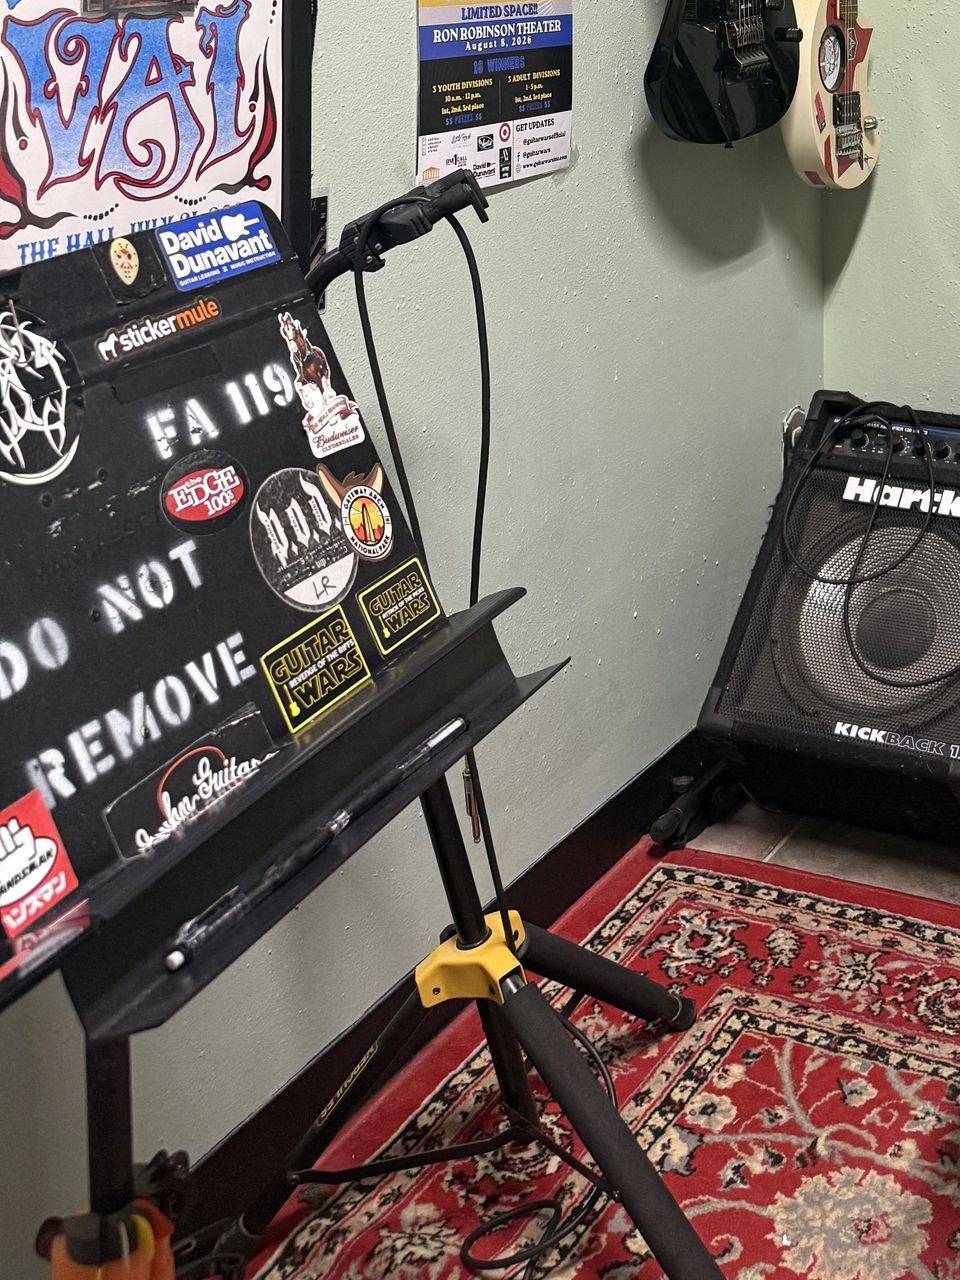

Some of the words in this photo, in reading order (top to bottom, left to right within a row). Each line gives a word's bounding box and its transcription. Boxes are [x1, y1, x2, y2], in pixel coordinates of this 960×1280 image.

[461, 5, 501, 20] LIMITED
[433, 27, 459, 43] RON
[462, 23, 516, 41] ROBINSON
[516, 20, 562, 35] THEATER
[465, 40, 498, 52] August
[511, 35, 532, 46] 2026
[437, 81, 461, 93] YOUTH
[461, 78, 493, 91] DIVISIONS
[532, 68, 561, 80] DIVISIONS
[515, 122, 528, 132] GET
[528, 118, 555, 130] UPDATES
[473, 162, 487, 170] David
[17, 236, 60, 265] THE
[159, 218, 223, 255] David
[168, 228, 273, 279] Dunavant
[118, 298, 220, 353] stickermule
[146, 398, 220, 460] FA
[225, 363, 294, 425] 119
[312, 425, 359, 449] Budweiser
[321, 434, 360, 453] CLYDESDALES
[168, 465, 241, 512] EDGE
[185, 477, 203, 489] the
[343, 487, 368, 510] GATEWAY
[368, 490, 386, 510] ARCH
[349, 535, 379, 555] NATIONAL
[377, 534, 392, 553] PARK
[96, 538, 204, 633] NOT
[312, 574, 337, 601] LR
[368, 571, 422, 617] GUITAR
[382, 605, 399, 619] ATTACK
[398, 600, 405, 608] OF
[404, 595, 414, 605] THE
[413, 586, 425, 600] PICKS
[384, 592, 431, 633] WARS
[269, 619, 351, 685] GUITAR
[289, 663, 320, 688] REVENGE
[318, 659, 326, 669] OF
[325, 651, 339, 665] THE
[338, 638, 355, 655] RIFFS
[292, 647, 363, 708] WARS
[24, 631, 258, 809] REMOVE
[834, 721, 945, 755] KICKBACK
